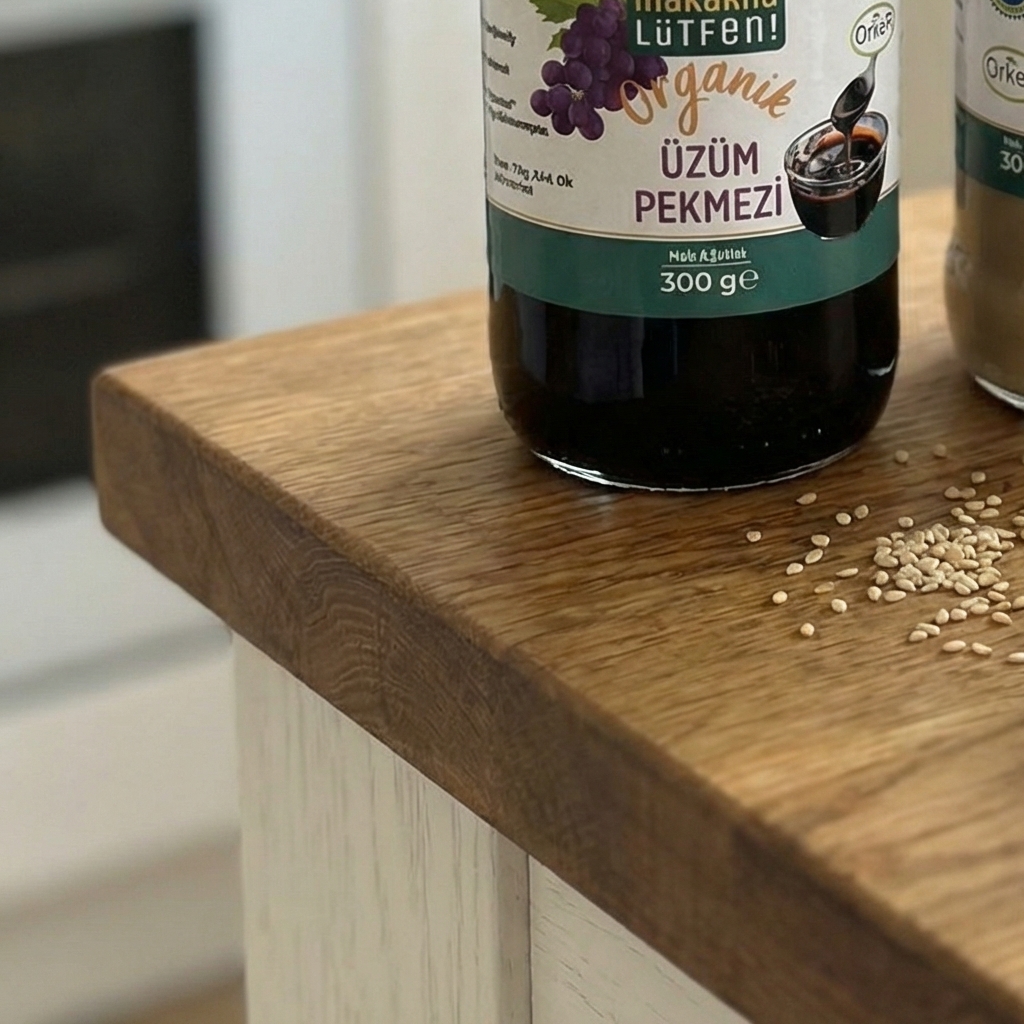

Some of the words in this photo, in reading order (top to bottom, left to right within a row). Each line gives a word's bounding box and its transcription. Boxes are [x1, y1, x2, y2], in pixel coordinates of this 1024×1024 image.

[619, 60, 798, 136] Organik
[661, 138, 759, 179] ÜZÜM
[634, 176, 783, 224] PEKMEZİ
[660, 272, 712, 293] 300
